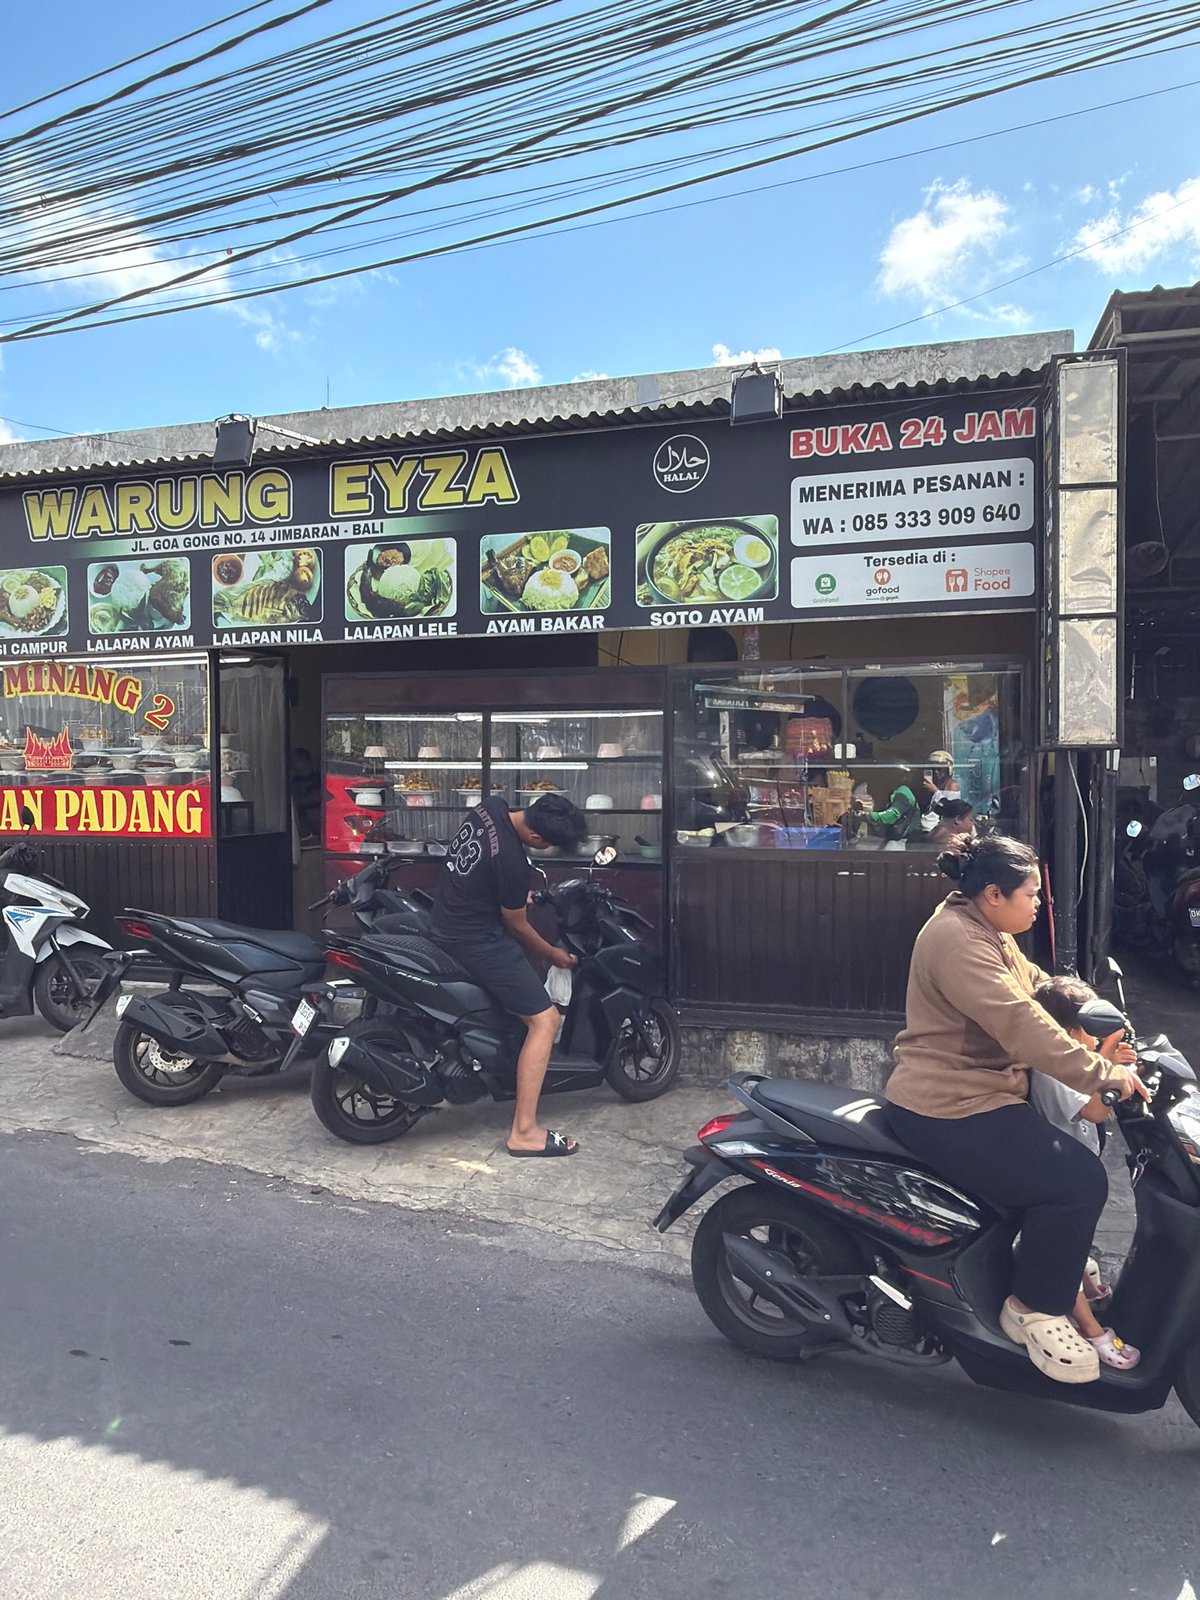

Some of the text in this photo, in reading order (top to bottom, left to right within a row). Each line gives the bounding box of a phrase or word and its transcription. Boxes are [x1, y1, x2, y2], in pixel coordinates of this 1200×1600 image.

[790, 407, 1036, 459] BUKA 24 JAM
[656, 445, 707, 473] حلال
[663, 472, 700, 482] HALAL
[799, 479, 906, 503] MENERIMA
[913, 470, 1012, 494] PESANAN
[22, 447, 520, 541] WARUNG EYZA
[802, 517, 834, 535] WA
[852, 513, 888, 532] 085
[894, 510, 931, 529] 333
[938, 507, 975, 526] 909
[982, 503, 1021, 522] 640
[131, 540, 149, 552] JL.
[153, 537, 179, 551] GOA
[183, 534, 220, 549] GONG
[224, 532, 246, 546] NO.
[250, 530, 266, 543] 14
[269, 525, 340, 542] JIMBARAN
[352, 522, 384, 536] BALI
[863, 552, 928, 567] Tersedia
[933, 551, 946, 563] di
[974, 568, 1011, 577] Shopee
[865, 585, 900, 597] gofood
[974, 577, 1011, 591] Food
[486, 615, 605, 634] AYAM BAKAR
[650, 607, 764, 626] SOTO AYAM
[212, 629, 323, 646] LALAPAN NILA
[344, 622, 458, 640] LALAPAN LELE
[11, 641, 68, 655] CAMPUR
[86, 635, 194, 652] LALAPAN AYAM
[3, 661, 175, 730] MINANG 2
[54, 790, 203, 834] PADANG
[449, 822, 482, 875] 83
